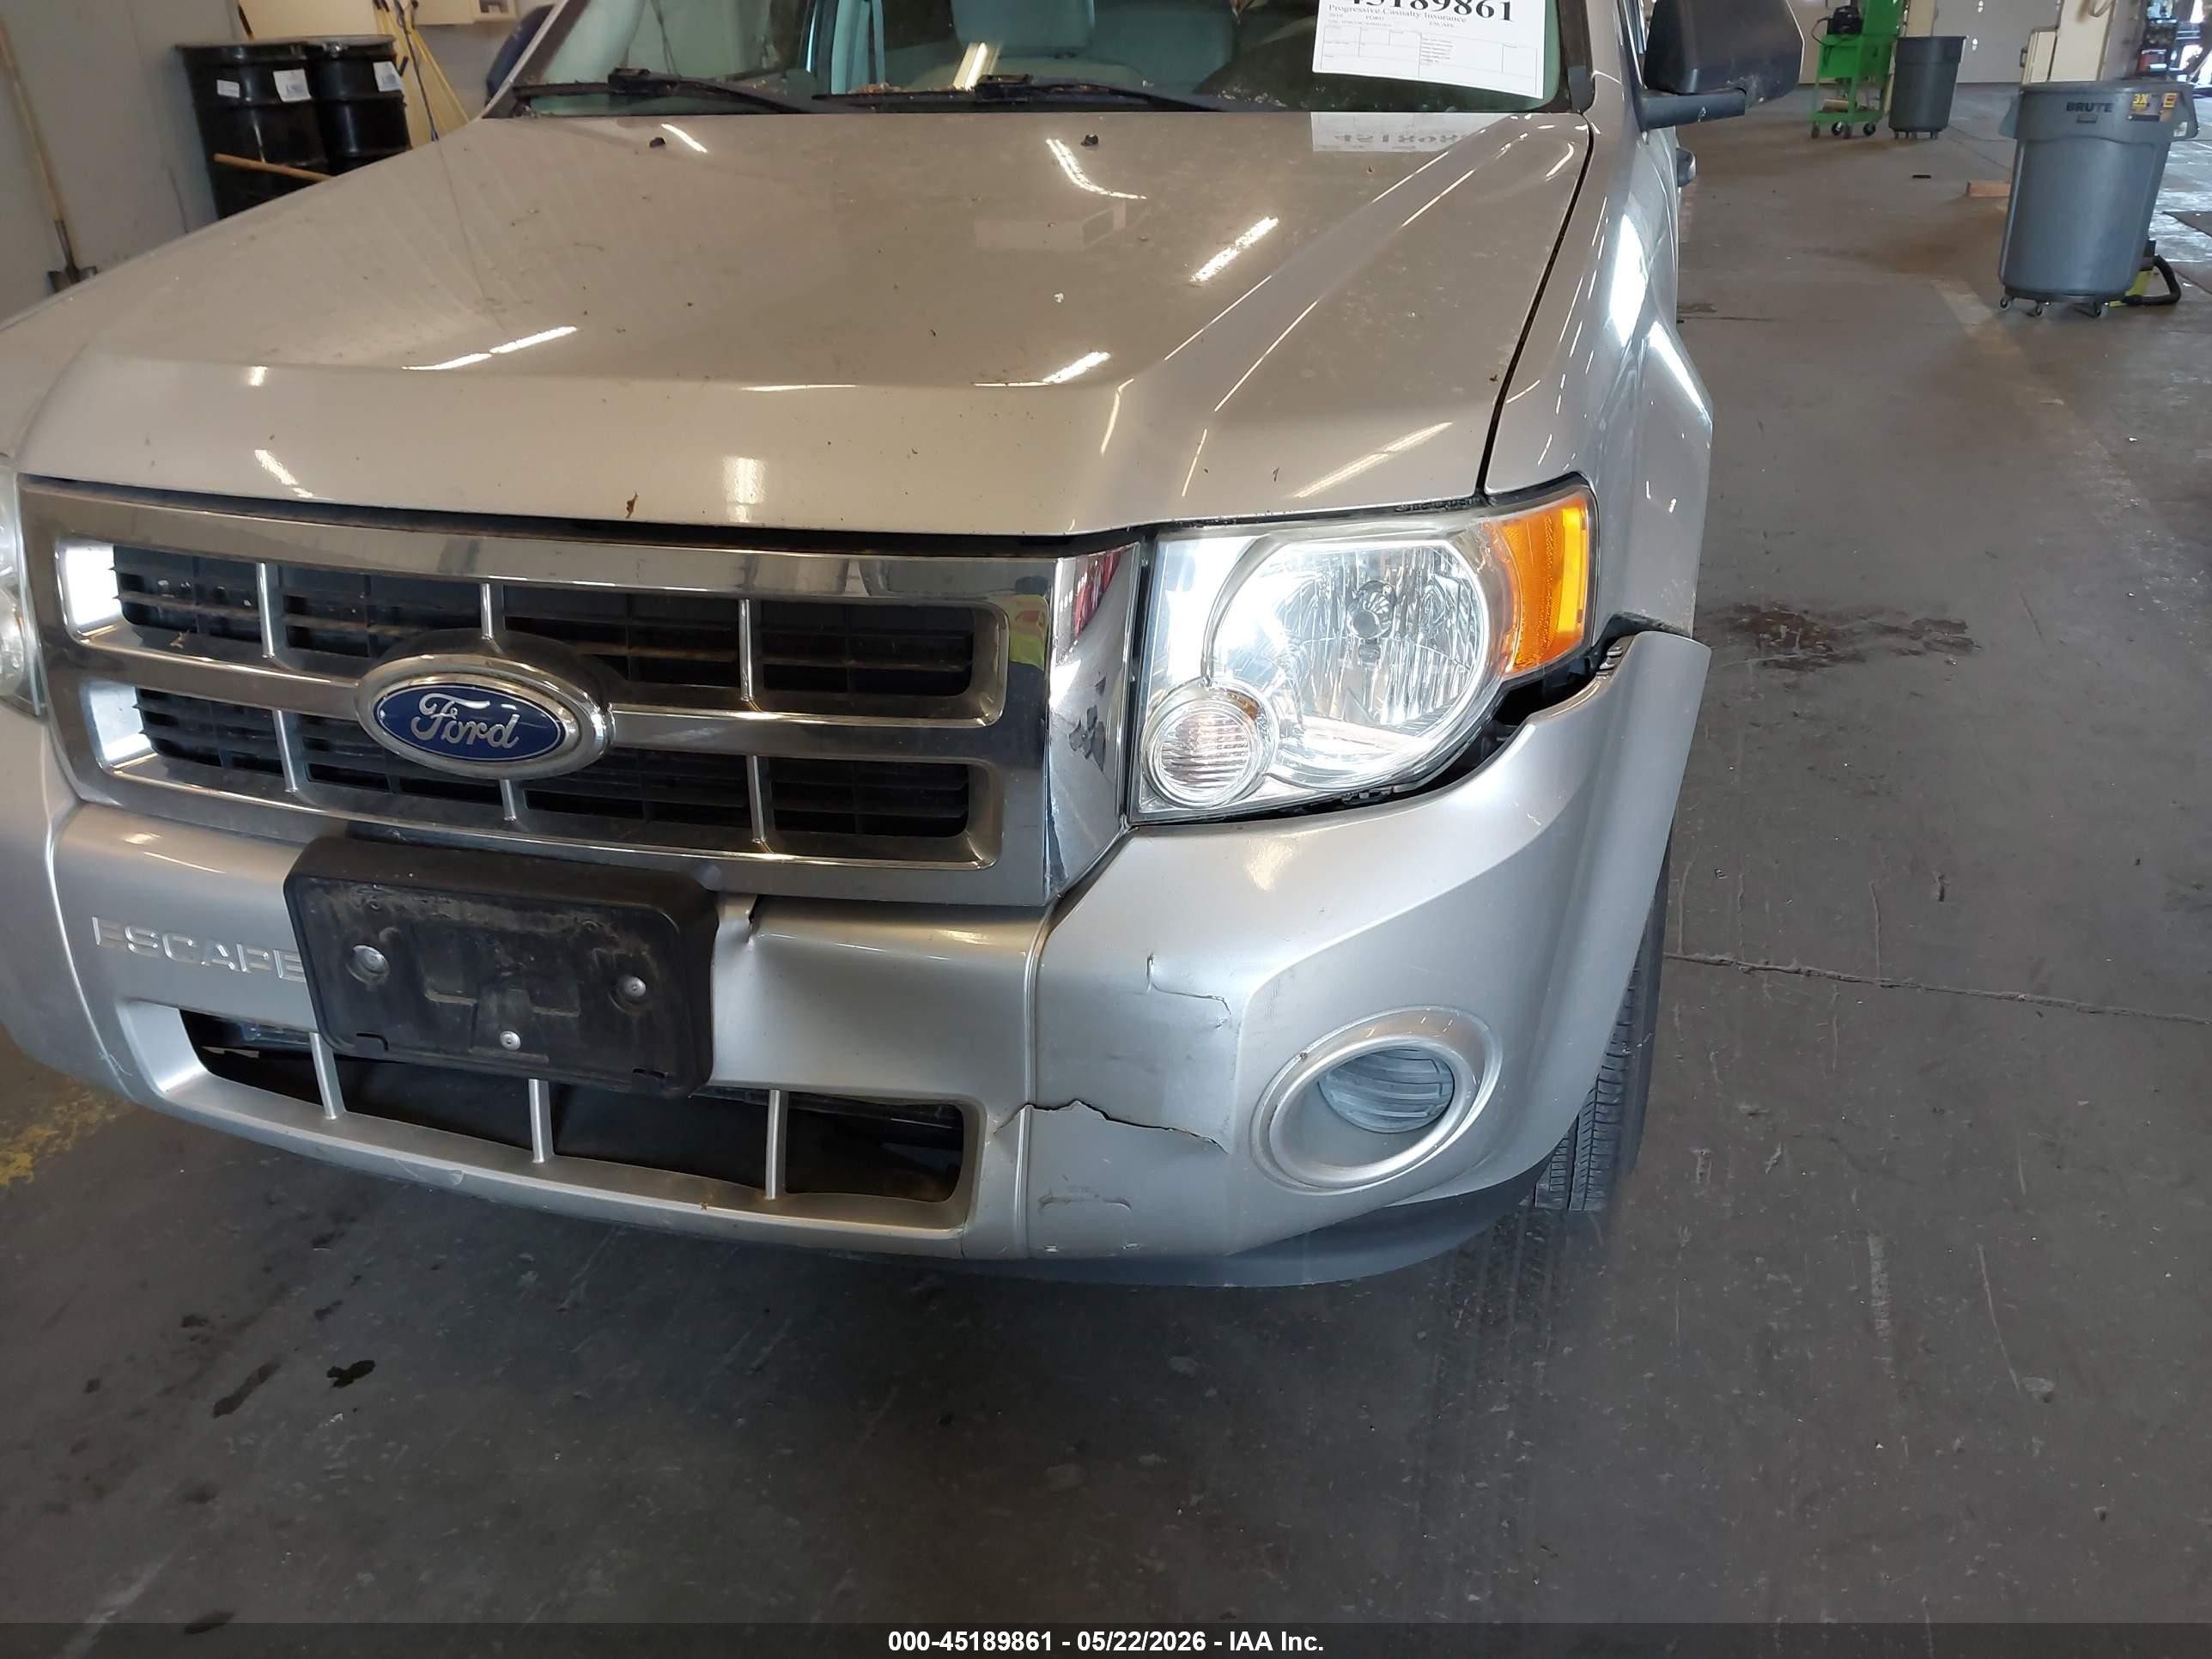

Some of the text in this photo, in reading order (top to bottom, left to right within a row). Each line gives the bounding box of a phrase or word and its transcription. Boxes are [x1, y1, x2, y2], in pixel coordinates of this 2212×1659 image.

[1328, 3, 1467, 22] Progressive Casualty Insurance
[1353, 0, 1516, 21] 89861
[2066, 102, 2112, 113] BRUTE
[410, 692, 520, 749] Ford
[91, 915, 307, 984] ESCAPE
